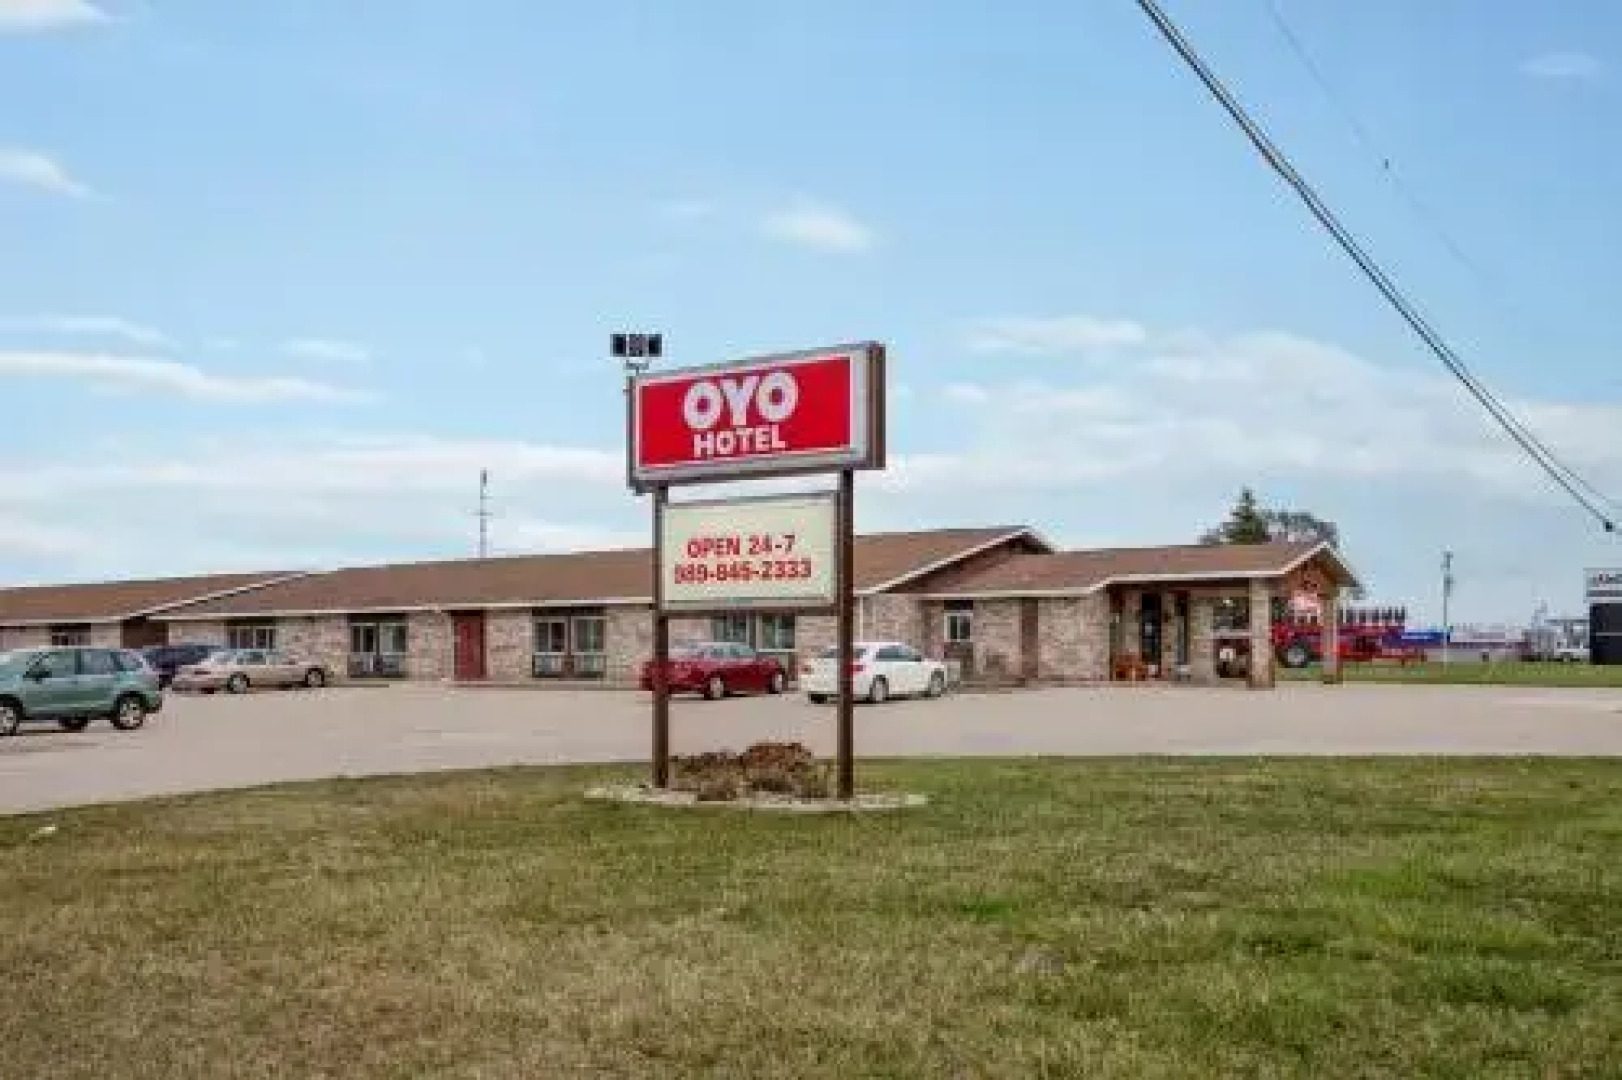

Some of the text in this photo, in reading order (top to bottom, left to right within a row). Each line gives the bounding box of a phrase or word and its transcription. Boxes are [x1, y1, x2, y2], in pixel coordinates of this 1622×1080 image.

[684, 371, 798, 430] OYO
[693, 424, 787, 458] HOTEL
[687, 534, 795, 558] OPEN 24-7
